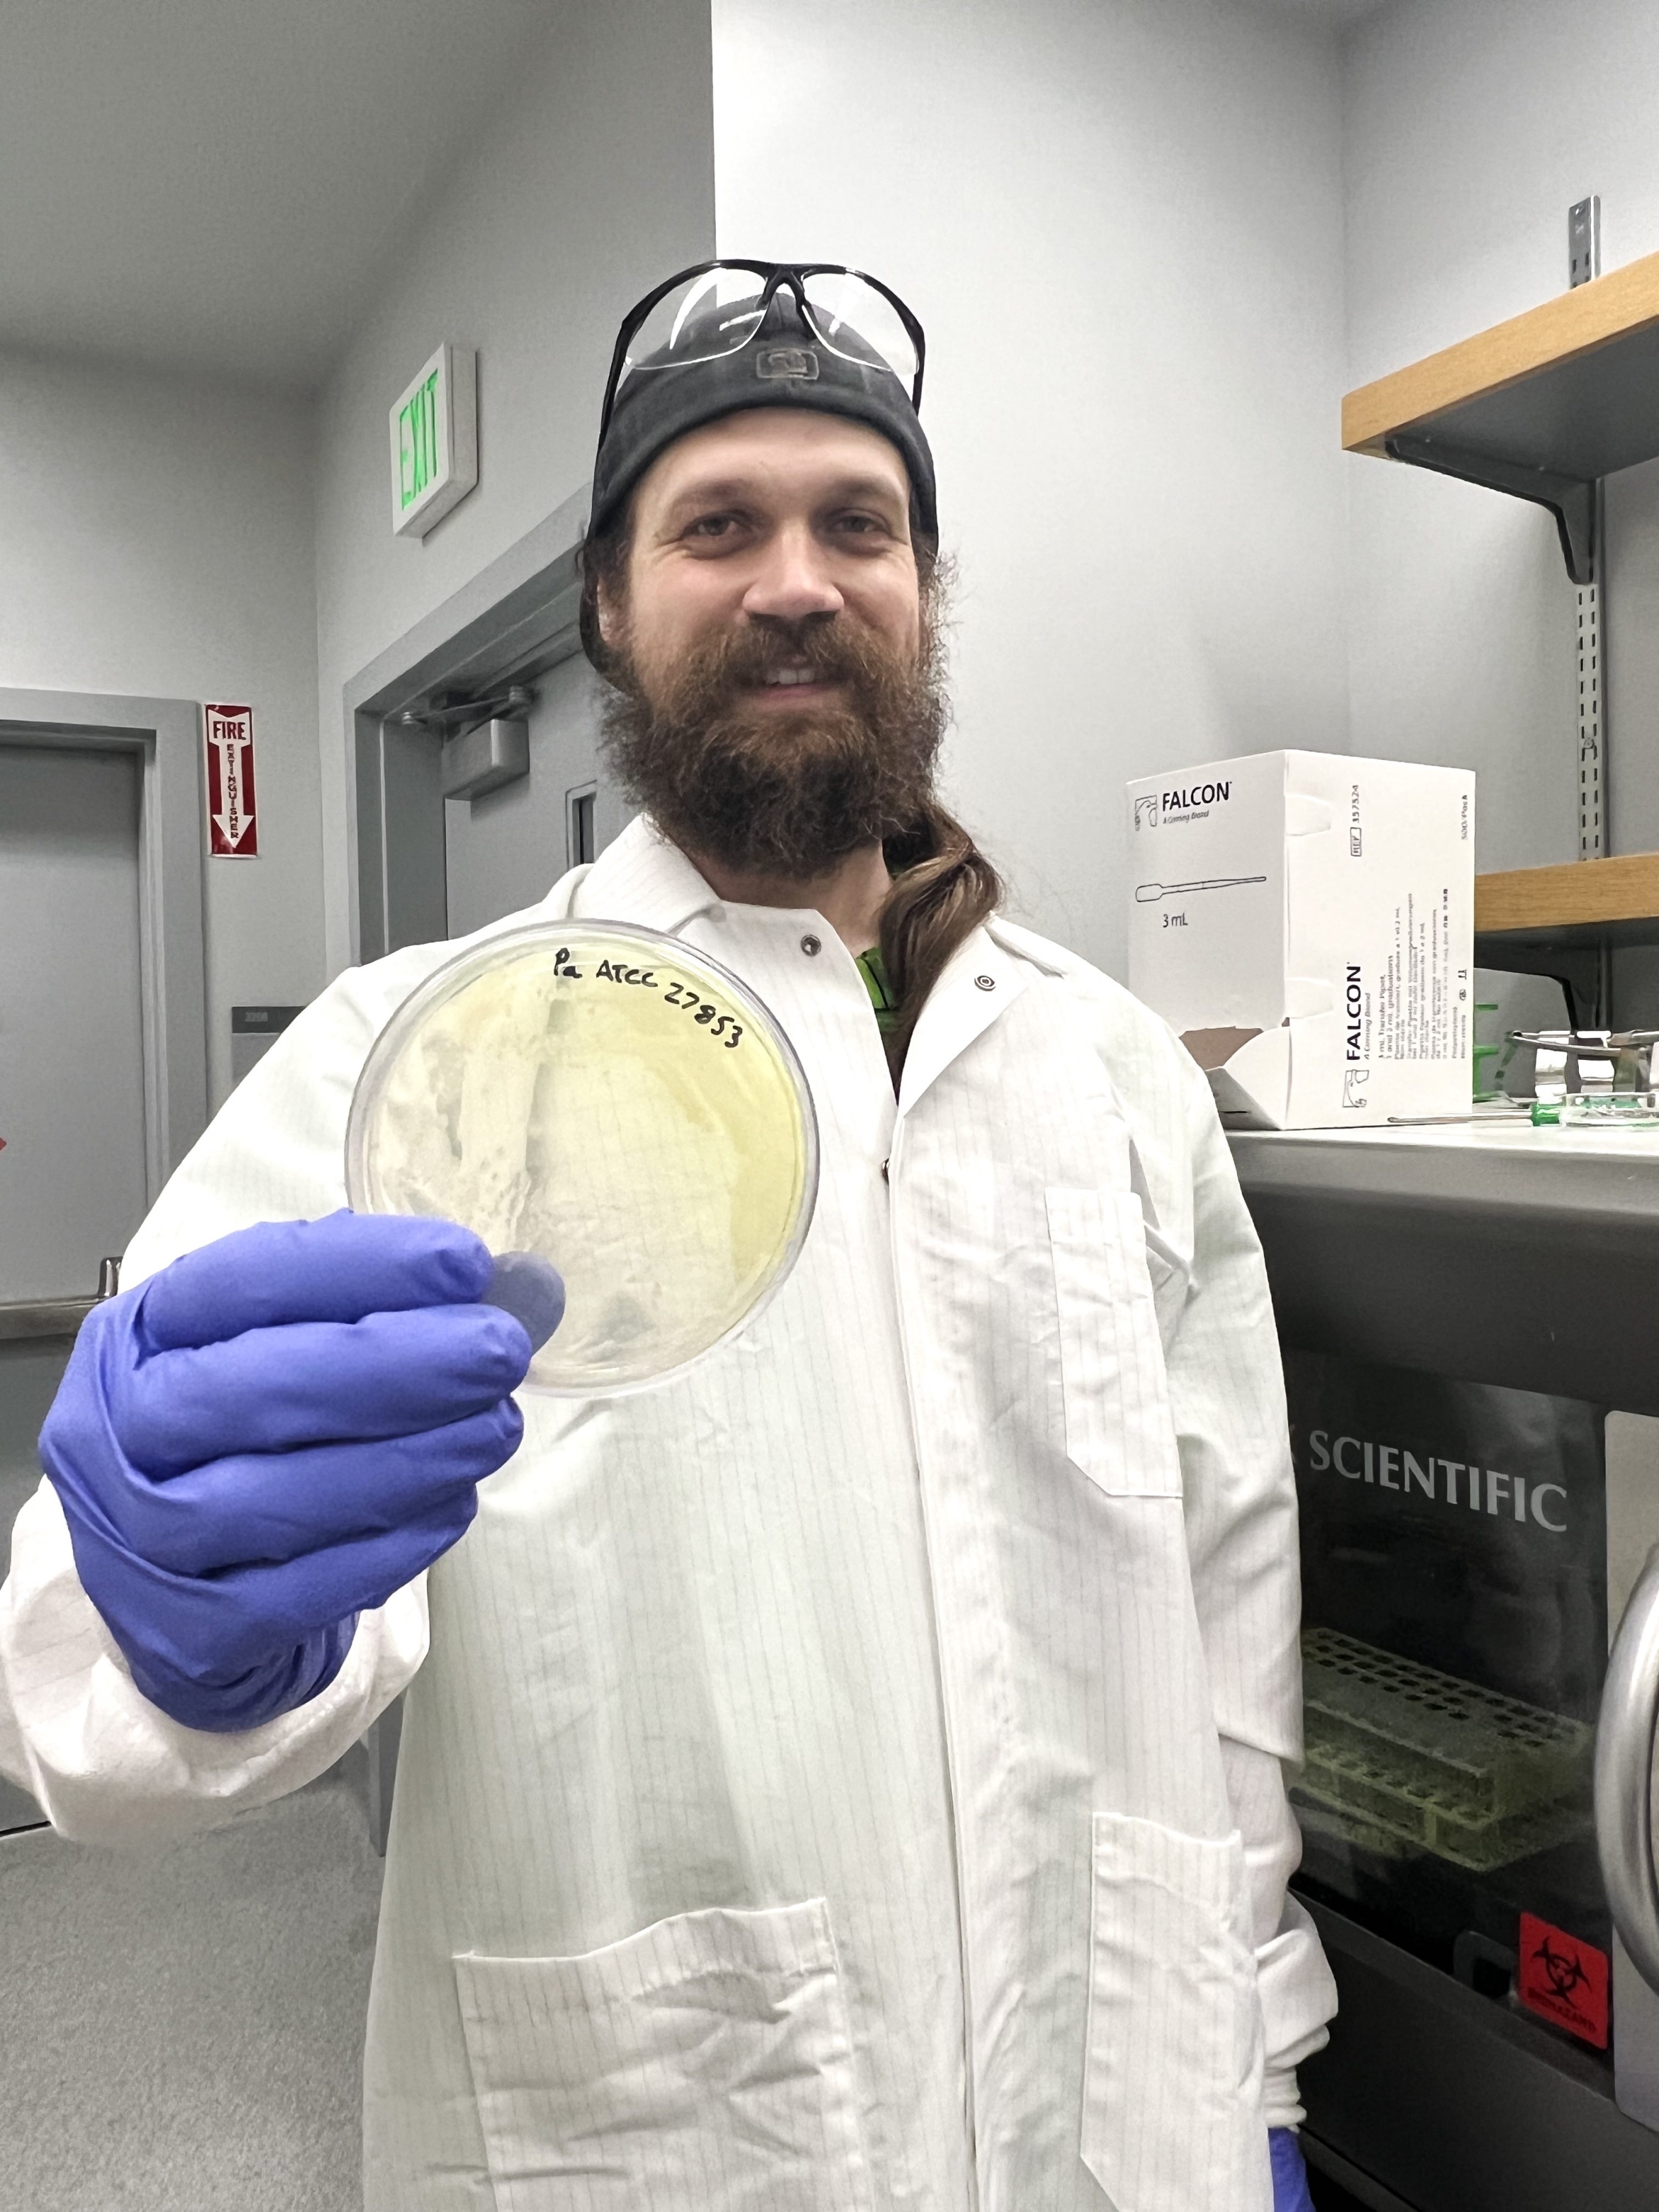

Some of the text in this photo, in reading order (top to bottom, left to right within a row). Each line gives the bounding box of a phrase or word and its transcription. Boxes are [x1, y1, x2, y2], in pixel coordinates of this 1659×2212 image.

[399, 368, 438, 511] EXIT
[213, 720, 247, 740] FIRE
[1162, 781, 1231, 812] FALCON
[1162, 914, 1169, 928] 3
[596, 960, 659, 988] ATCC
[664, 983, 743, 1048] 27853
[1346, 965, 1361, 1061] FALCON
[1309, 1429, 1568, 1532] SCIENTIFIC
